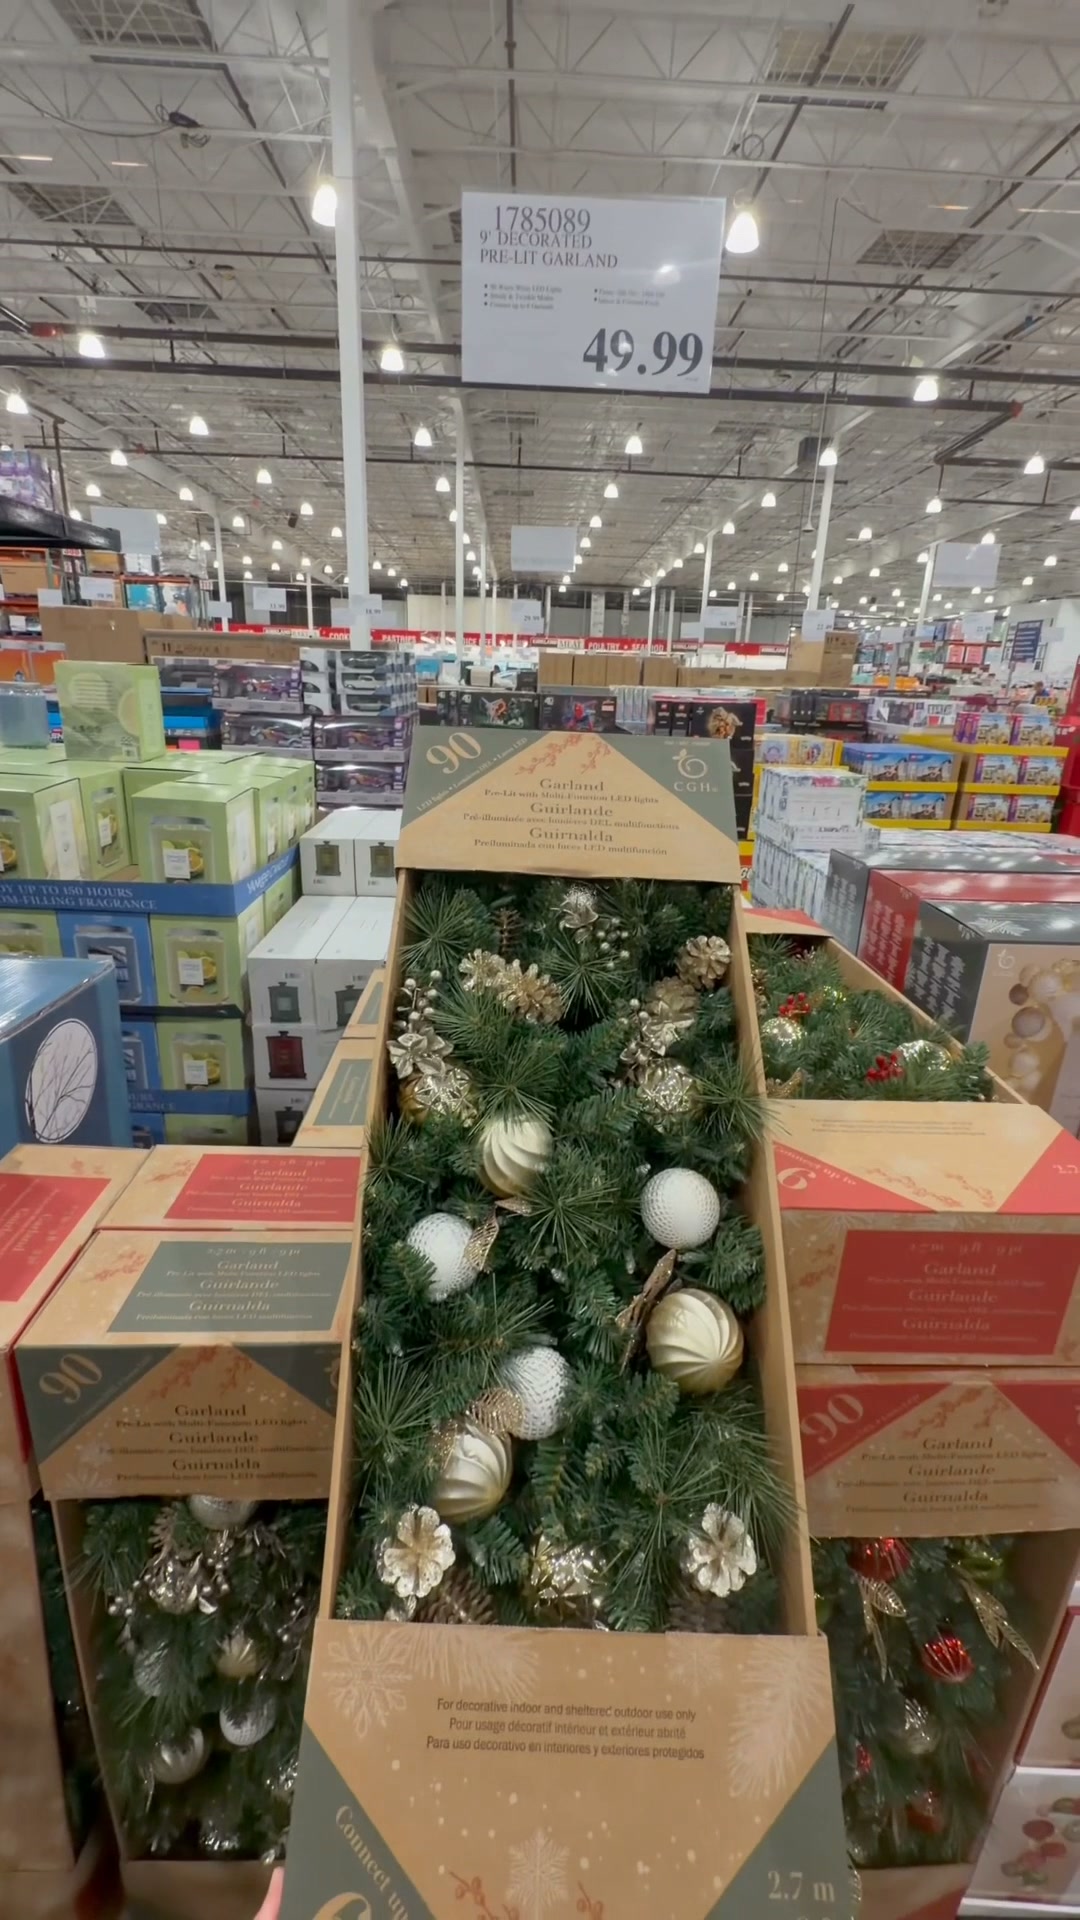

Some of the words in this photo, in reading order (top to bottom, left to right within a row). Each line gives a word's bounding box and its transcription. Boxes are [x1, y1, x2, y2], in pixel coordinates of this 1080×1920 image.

[495, 205, 591, 233] 1785089
[497, 231, 592, 249] DECORATED
[480, 248, 538, 266] PRE-LIT
[542, 252, 618, 268] GARLAND
[583, 328, 703, 377] 49.99
[588, 641, 620, 652] POULTRY
[426, 732, 482, 774] 90
[540, 778, 604, 791] Garland
[674, 781, 711, 793] CGH
[484, 789, 516, 798] Pre-Lit
[519, 791, 538, 799] with
[610, 794, 632, 802] LED
[634, 795, 659, 804] lights
[530, 802, 613, 817] Guirlande
[590, 818, 612, 826] DEL
[529, 827, 613, 842] Guirnalda
[583, 843, 606, 852] LED
[18, 885, 36, 894] UP
[40, 885, 59, 895] TO
[63, 886, 83, 896] 150
[87, 887, 133, 898] HOURS
[79, 898, 158, 911] FRAGRANCE
[777, 1166, 817, 1191] 6
[217, 1260, 279, 1270] Garland
[923, 1262, 998, 1276] Garland
[200, 1279, 280, 1290] Guirlande
[908, 1288, 998, 1304] Guirlande
[189, 1300, 271, 1312] Guirnalda
[902, 1317, 991, 1331] Guirnalda
[39, 1353, 103, 1404] 90
[174, 1403, 248, 1417] Garland
[800, 1393, 864, 1443] 90
[169, 1430, 259, 1445] Guirlande
[922, 1437, 993, 1450] Garland
[172, 1457, 261, 1472] Guirnalda
[908, 1464, 996, 1477] Guirlande
[902, 1490, 989, 1503] Guirnalda
[437, 1697, 454, 1711] For
[456, 1699, 508, 1713] decorative
[510, 1701, 541, 1714] indoor
[543, 1704, 564, 1715] and
[565, 1704, 612, 1717] sheltered
[614, 1706, 653, 1719] outdoor
[655, 1709, 674, 1720] use
[675, 1709, 697, 1722] only
[449, 1717, 473, 1730] Pour
[475, 1720, 506, 1734] usage
[508, 1720, 552, 1733] décoratif
[555, 1722, 597, 1736] intérieur
[599, 1725, 608, 1737] et
[611, 1724, 654, 1738] extérieur
[657, 1726, 687, 1740] abrité
[426, 1735, 450, 1749] Para
[452, 1740, 472, 1750] uso
[473, 1738, 527, 1752] decorativo
[528, 1742, 542, 1753] en
[543, 1742, 592, 1755] interiores
[593, 1746, 599, 1758] y
[601, 1745, 651, 1757] exteriores
[652, 1748, 705, 1760] protegidos
[336, 1805, 391, 1893] Connect
[767, 1871, 803, 1900] 2.7
[812, 1881, 835, 1902] m
